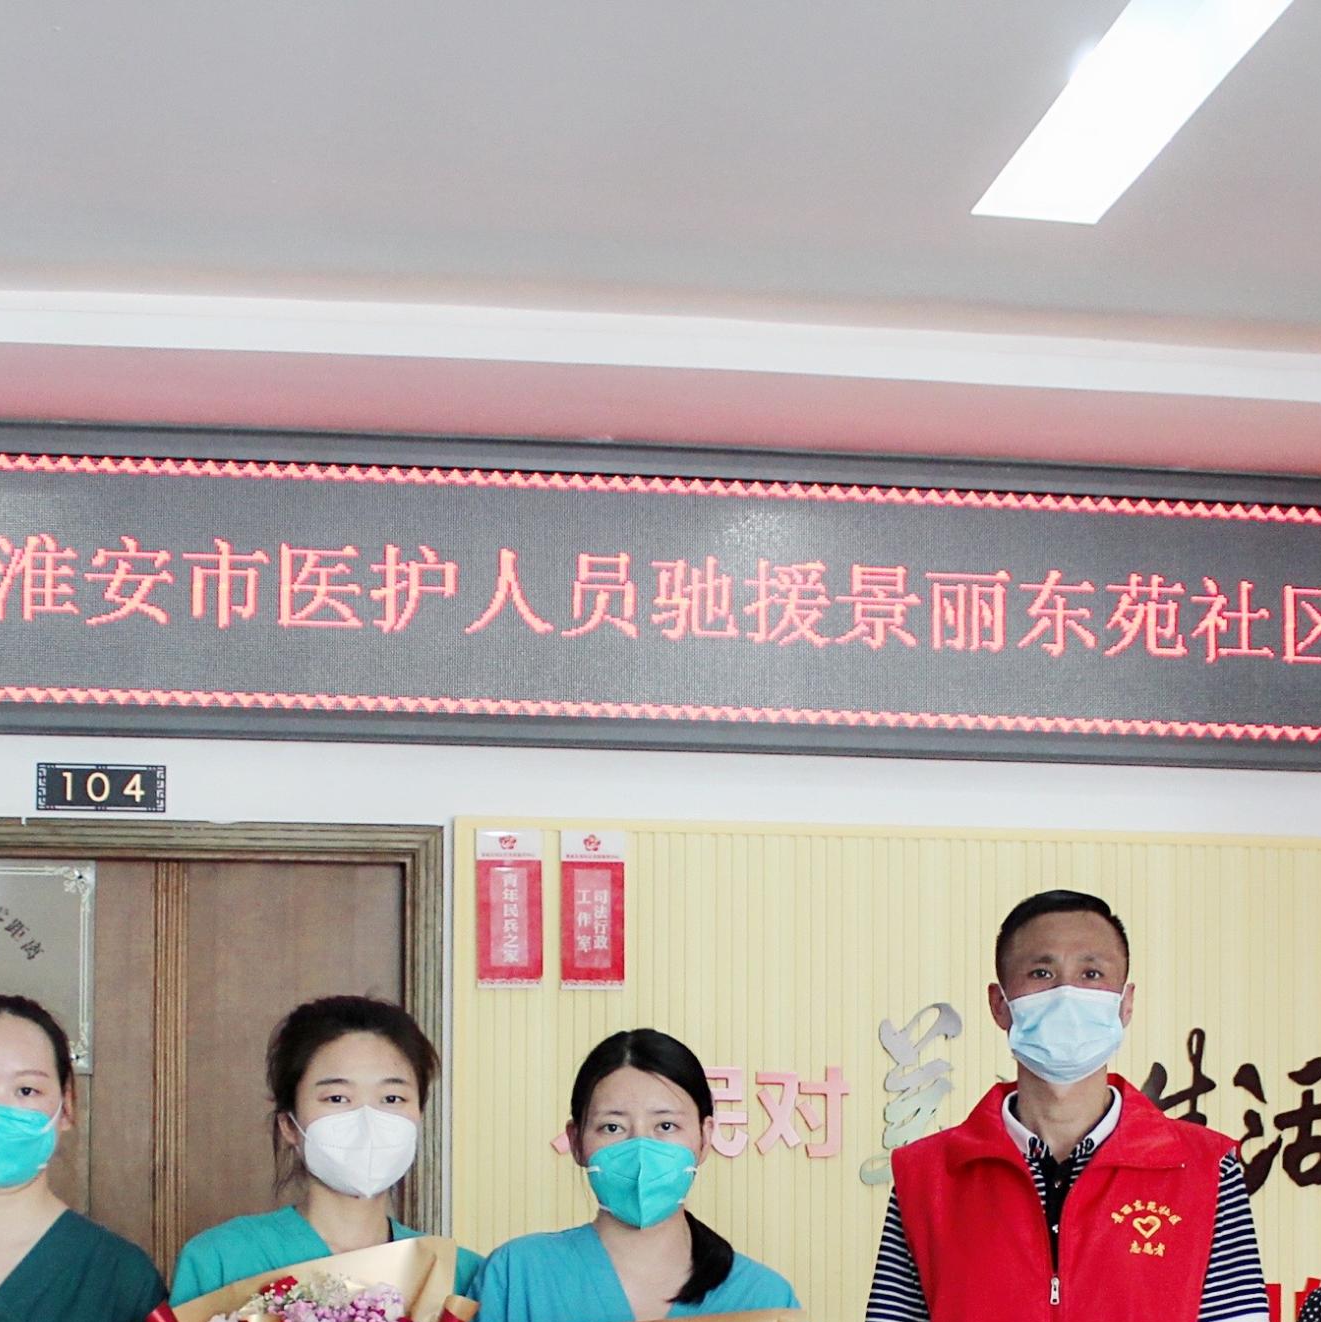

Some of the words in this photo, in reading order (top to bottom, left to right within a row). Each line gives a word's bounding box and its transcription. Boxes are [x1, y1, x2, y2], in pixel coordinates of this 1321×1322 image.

[61, 772, 146, 802] 104
[577, 889, 591, 952] 工作室
[593, 889, 608, 949] 司法行政
